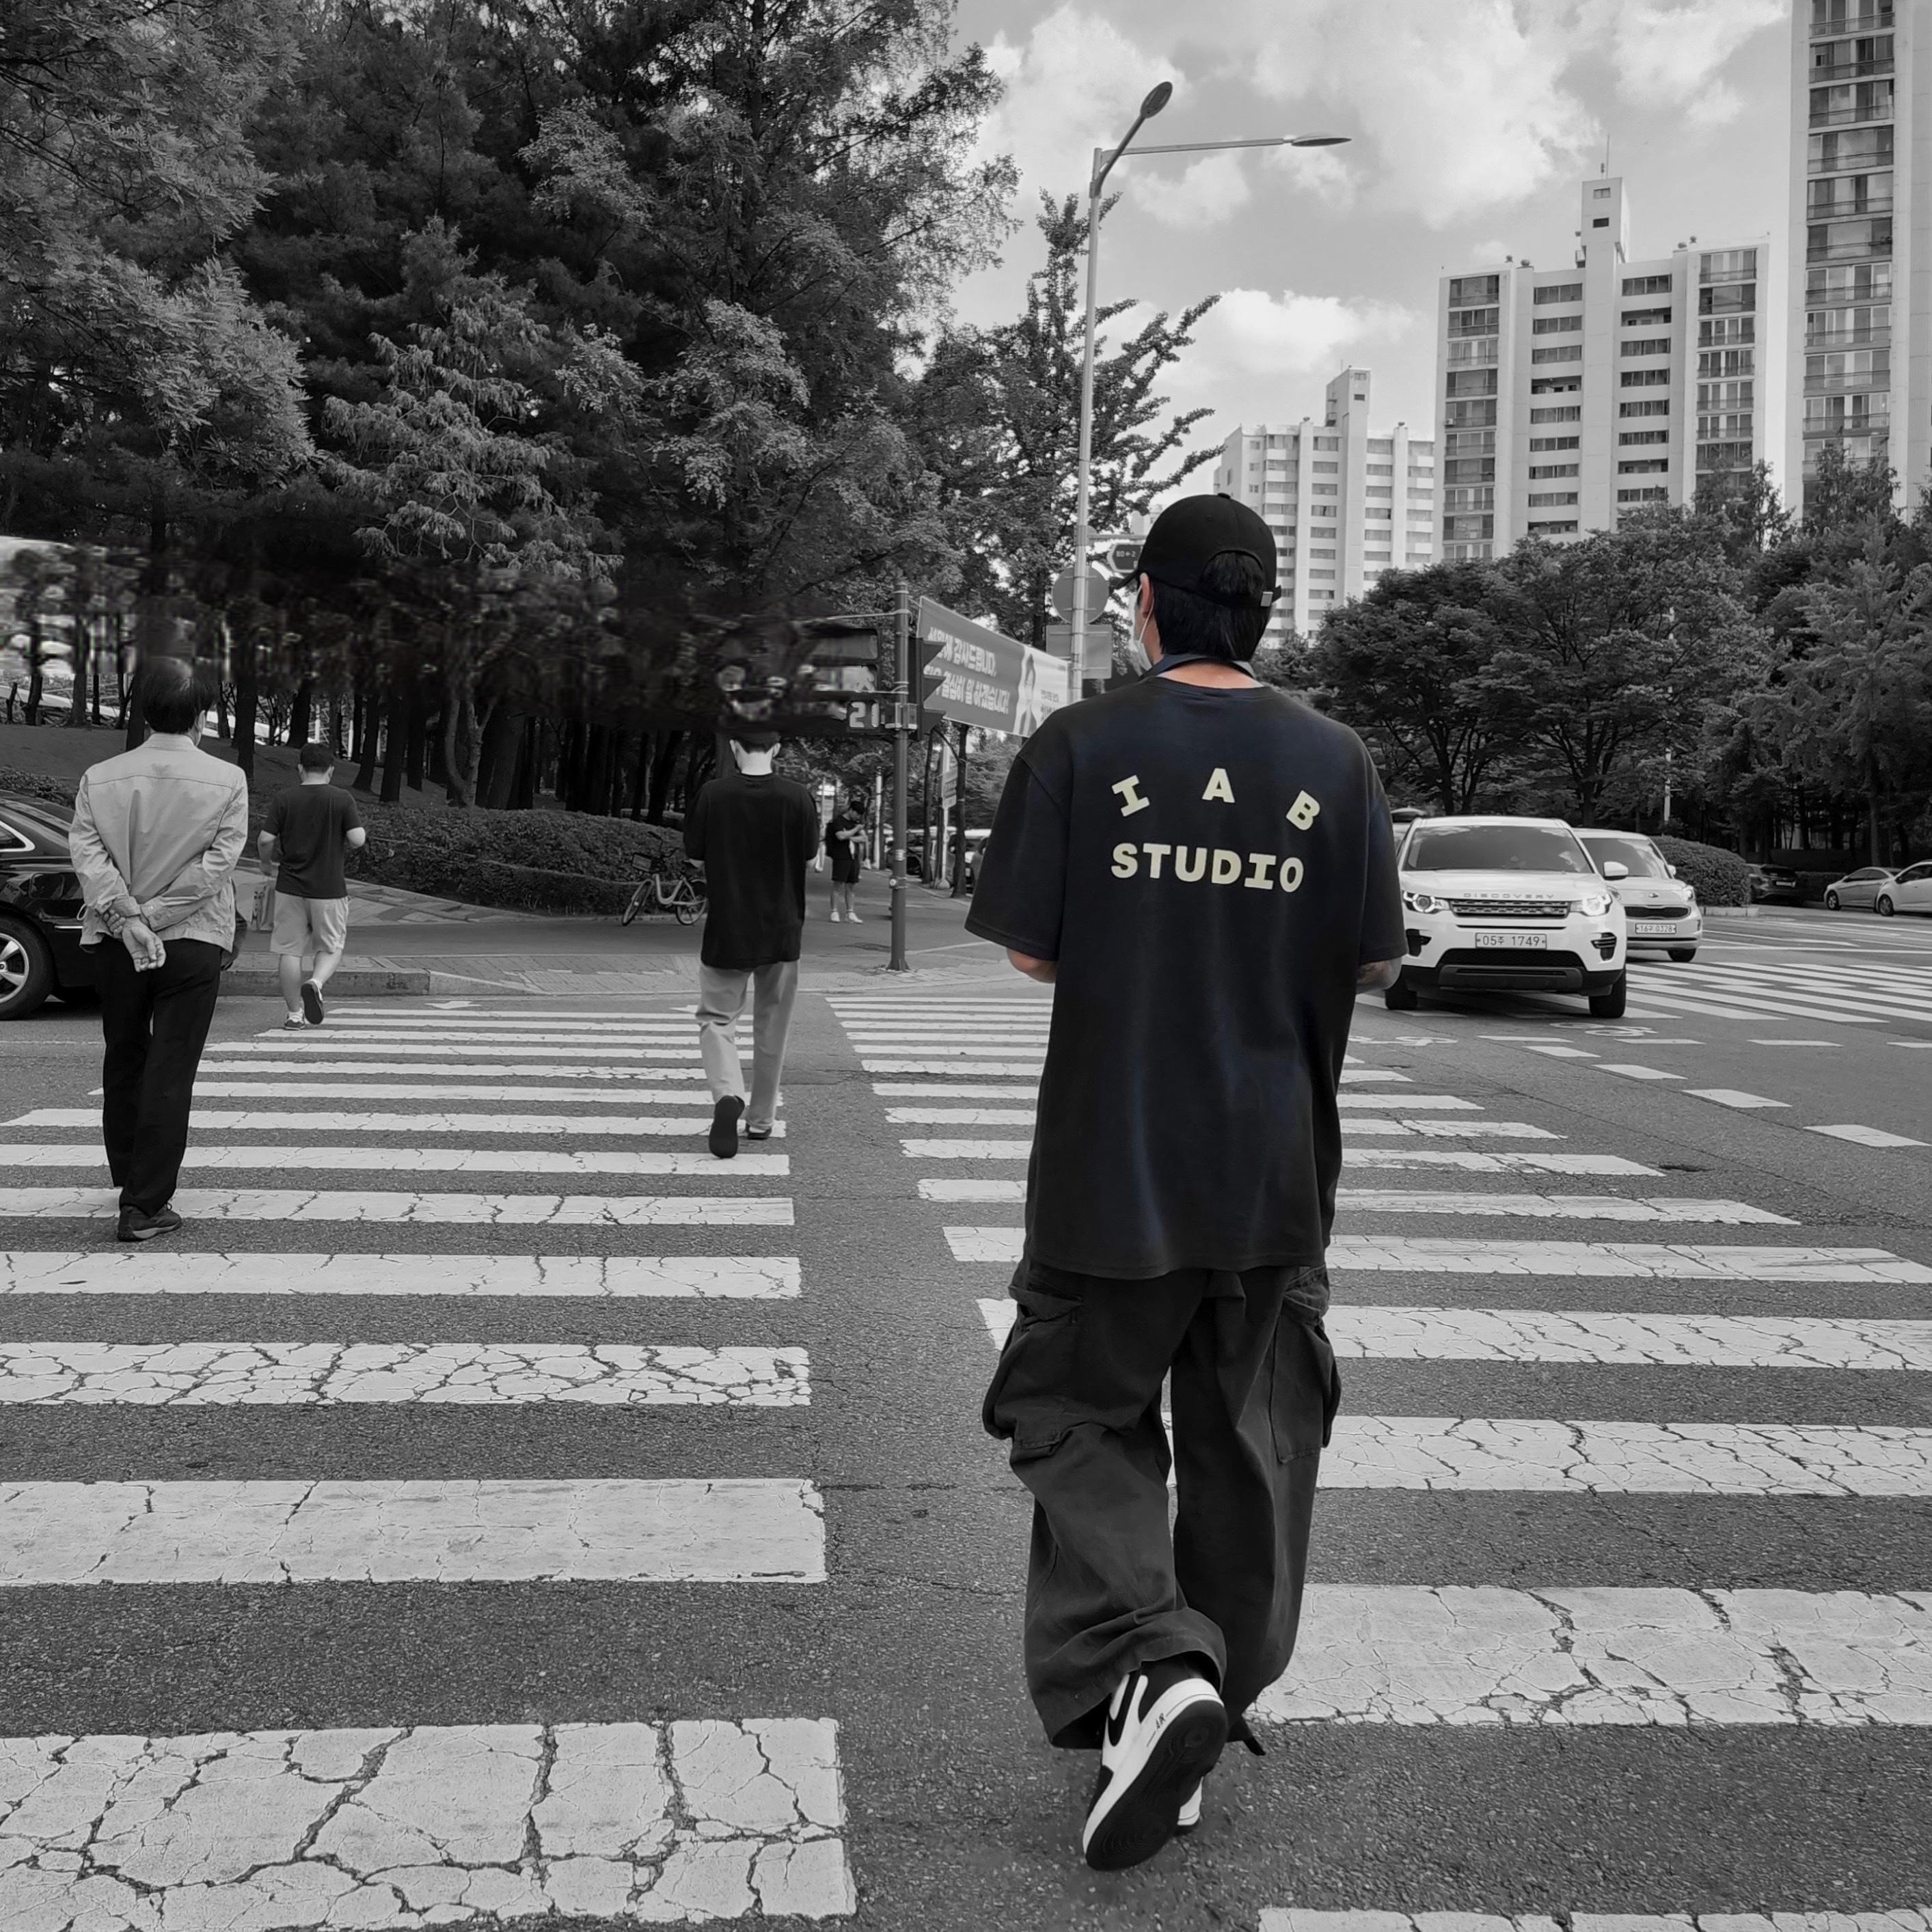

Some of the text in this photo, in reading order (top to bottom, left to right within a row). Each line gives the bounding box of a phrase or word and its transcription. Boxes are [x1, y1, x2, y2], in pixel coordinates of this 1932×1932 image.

[849, 701, 880, 728] 21
[1111, 843, 1304, 893] STUDIO
[1511, 935, 1540, 947] 1749
[1155, 1712, 1166, 1732] AIR
